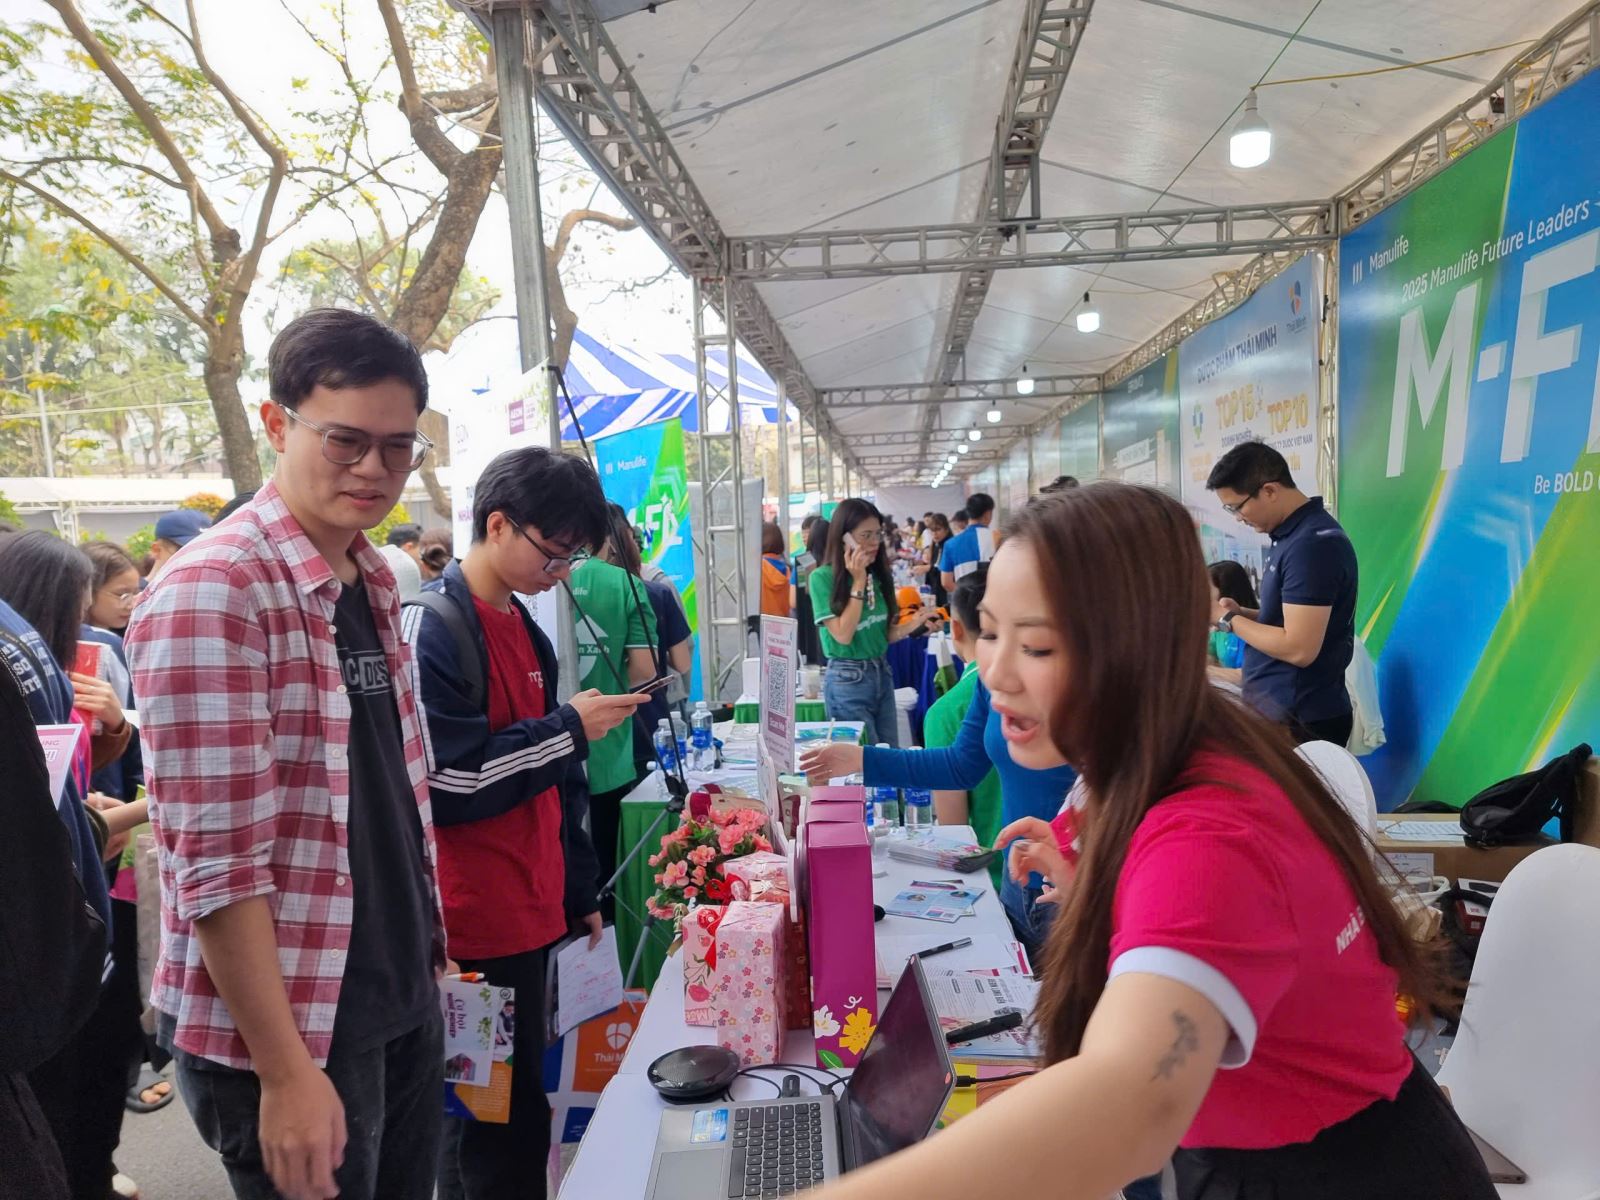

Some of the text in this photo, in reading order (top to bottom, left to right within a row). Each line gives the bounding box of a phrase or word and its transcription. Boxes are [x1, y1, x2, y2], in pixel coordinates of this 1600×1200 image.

[1369, 235, 1409, 274] Manulife
[1401, 199, 1590, 304] 2025 Manulife Future Leaders
[1255, 324, 1278, 354] MINH
[1267, 400, 1293, 435] TOP
[618, 455, 647, 471] Manulife
[1534, 470, 1594, 494] Be BOLD
[769, 716, 778, 728] Scan
[1336, 912, 1360, 955] NHÀ
